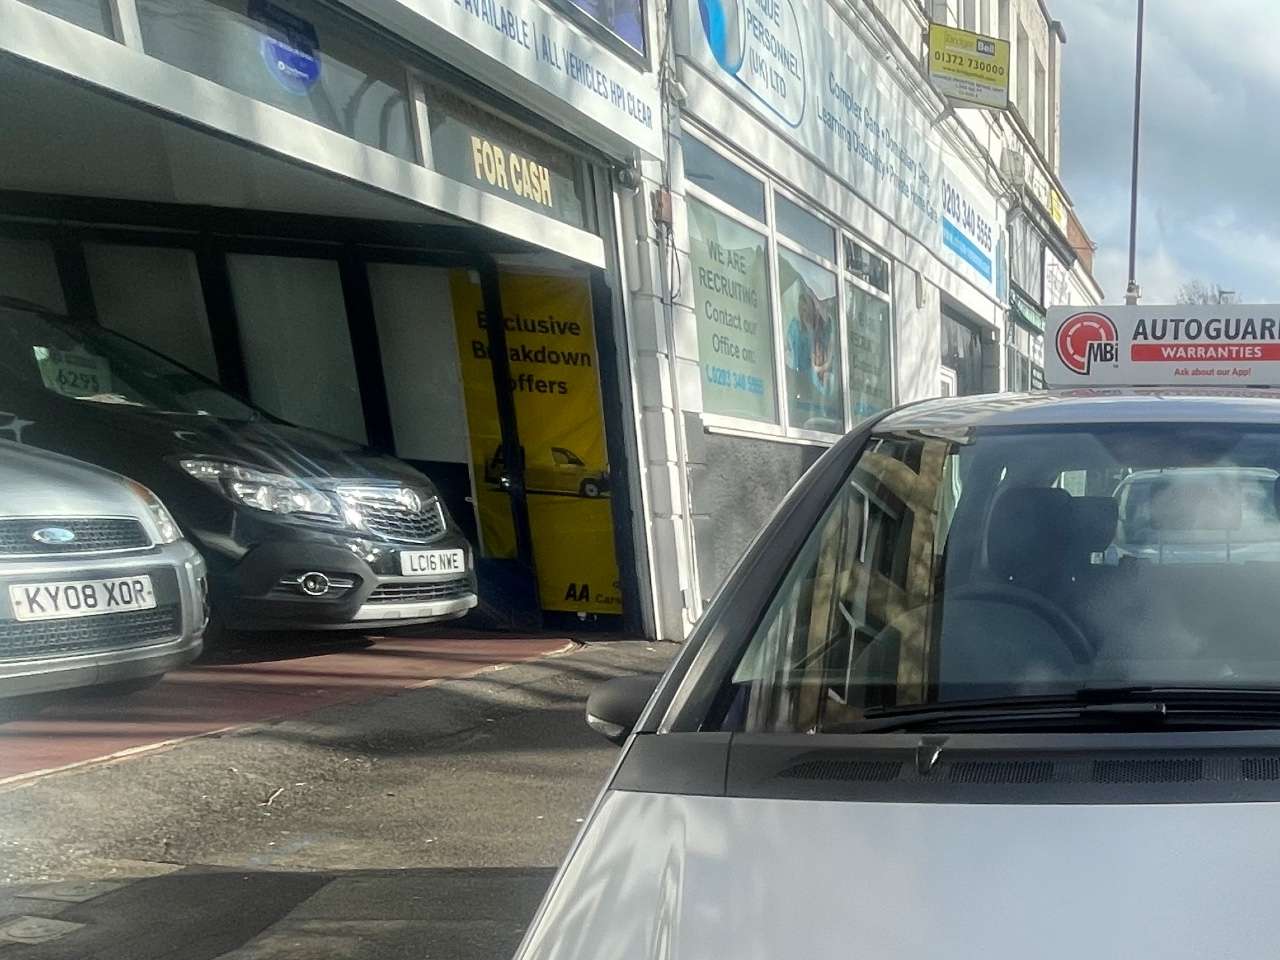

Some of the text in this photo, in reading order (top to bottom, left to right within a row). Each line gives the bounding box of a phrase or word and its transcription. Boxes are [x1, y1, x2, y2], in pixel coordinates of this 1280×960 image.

[746, 8, 801, 81] PERSONNEL
[934, 50, 964, 66] 01372
[967, 58, 1005, 76] 730000
[542, 35, 561, 71] ALL
[563, 48, 608, 99] VEHICLES
[610, 80, 625, 112] HPI
[627, 92, 653, 129] CLEAR
[770, 66, 786, 99] LTD
[829, 71, 862, 122] Complex
[817, 96, 851, 152] Learning
[471, 136, 552, 208] FOR CASH
[942, 178, 960, 223] 0203
[707, 239, 747, 275] WE ARE
[700, 267, 758, 309] RECRUITING
[477, 311, 581, 336] Eclusive
[705, 300, 742, 330] Contact
[472, 341, 592, 367] Bakdown
[712, 332, 741, 359] Office
[1160, 346, 1263, 359] WARRANTIES
[1174, 367, 1189, 376] Ask
[1191, 367, 1214, 376] about
[1232, 367, 1252, 377] App!
[410, 553, 459, 572] LC16 NWE
[25, 579, 146, 613] KY08 XOR
[565, 583, 590, 602] AA
